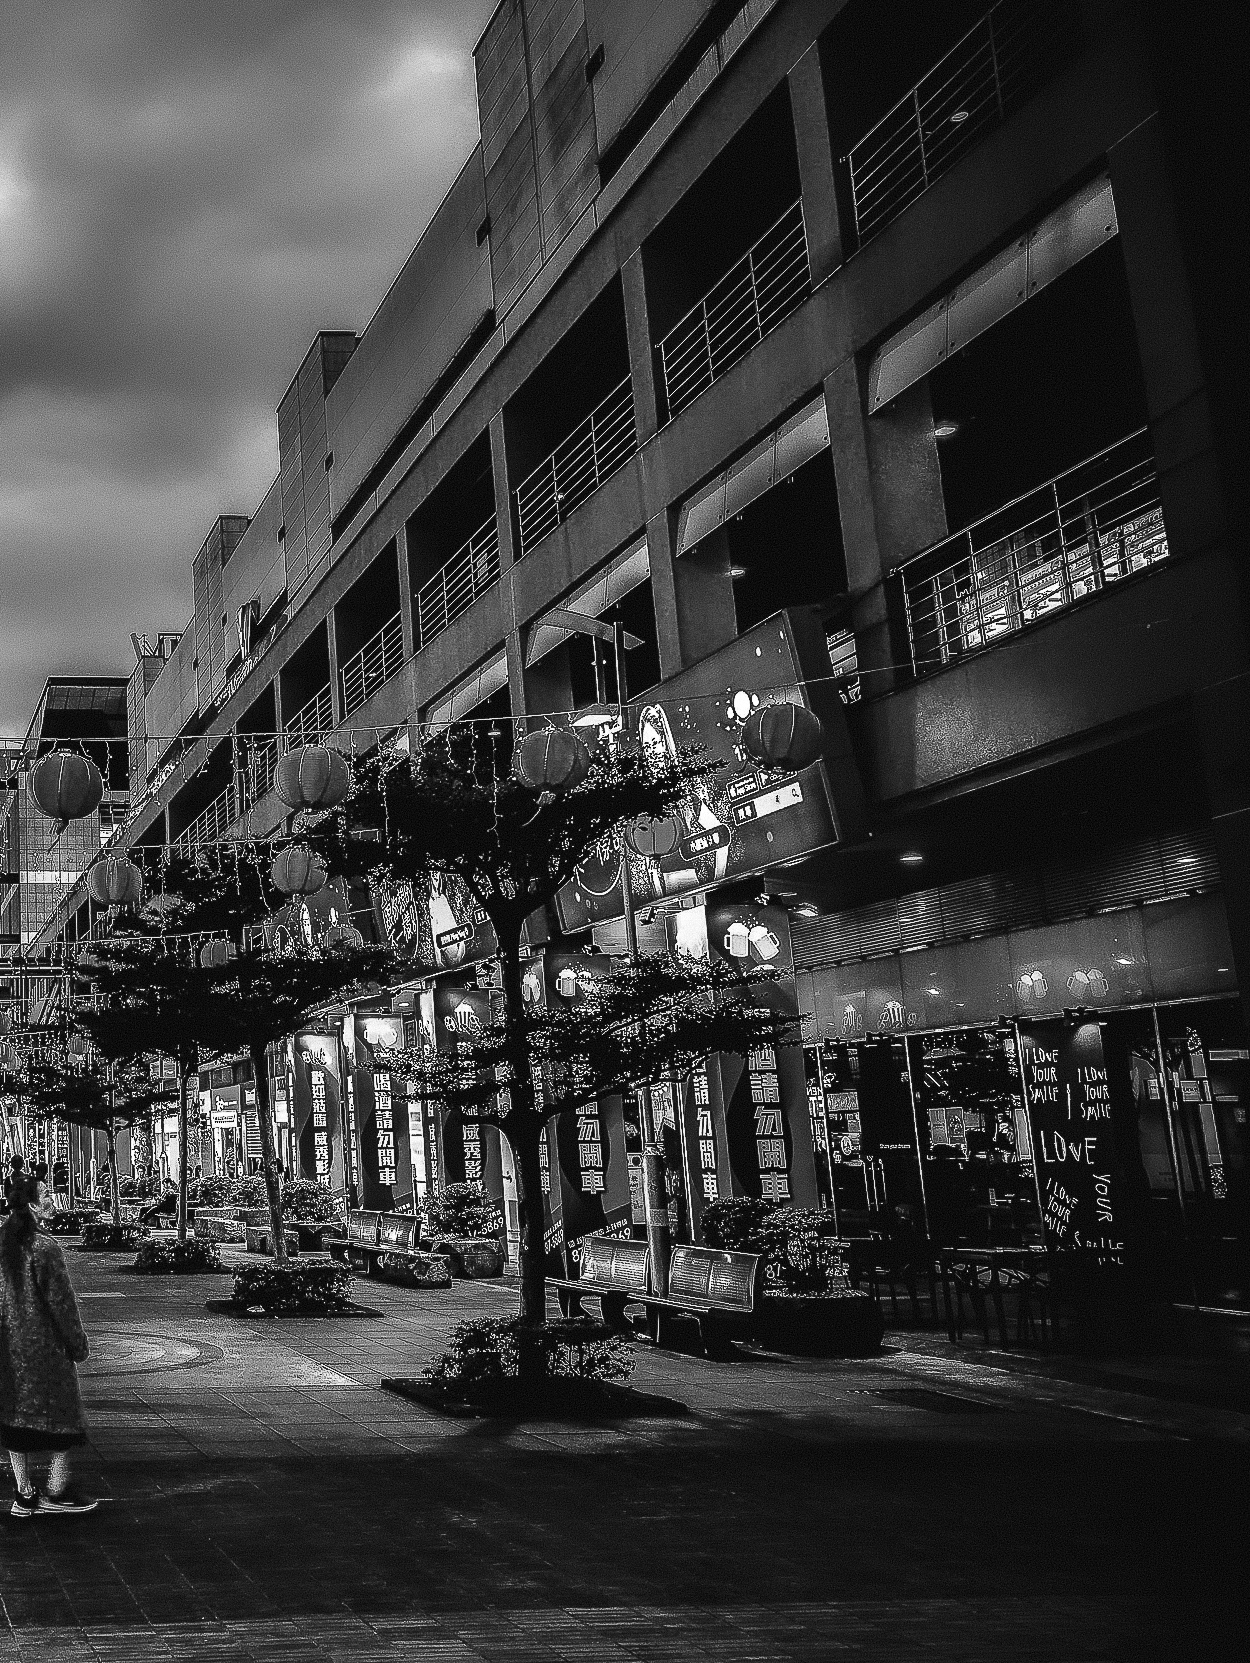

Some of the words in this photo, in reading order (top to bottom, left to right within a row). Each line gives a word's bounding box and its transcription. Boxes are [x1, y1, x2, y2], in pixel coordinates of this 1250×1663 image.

[1032, 1065, 1058, 1082] YOUR
[311, 1070, 327, 1127] 歡迎蒞臨
[1029, 1085, 1059, 1104] SMILE
[1084, 1084, 1110, 1102] YOUR
[1081, 1103, 1111, 1121] SMILE
[374, 1073, 397, 1186] 喝酒請勿開車
[1040, 1130, 1097, 1165] LOVE
[1092, 1173, 1113, 1222] YOUR
